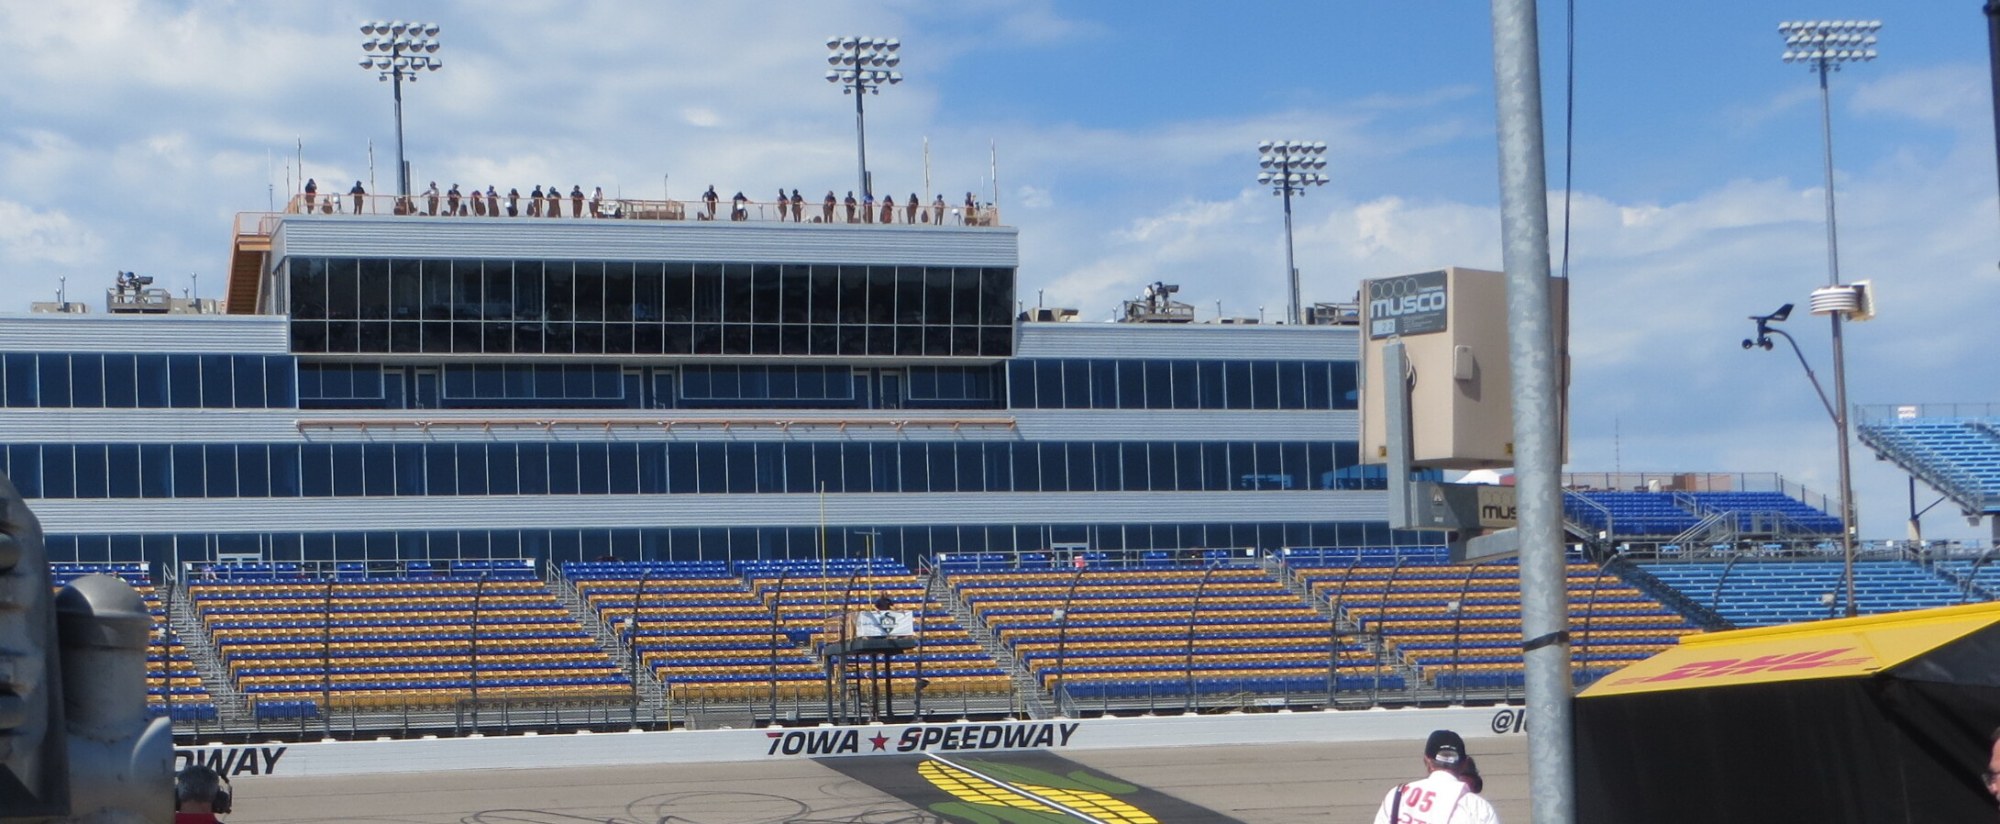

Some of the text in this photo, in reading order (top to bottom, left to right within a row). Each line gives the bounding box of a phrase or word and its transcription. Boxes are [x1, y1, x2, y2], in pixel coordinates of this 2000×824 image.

[1638, 647, 1856, 683] DHL
[1492, 709, 1527, 734] @I
[766, 723, 1080, 756] IOWA SPEEDWAY
